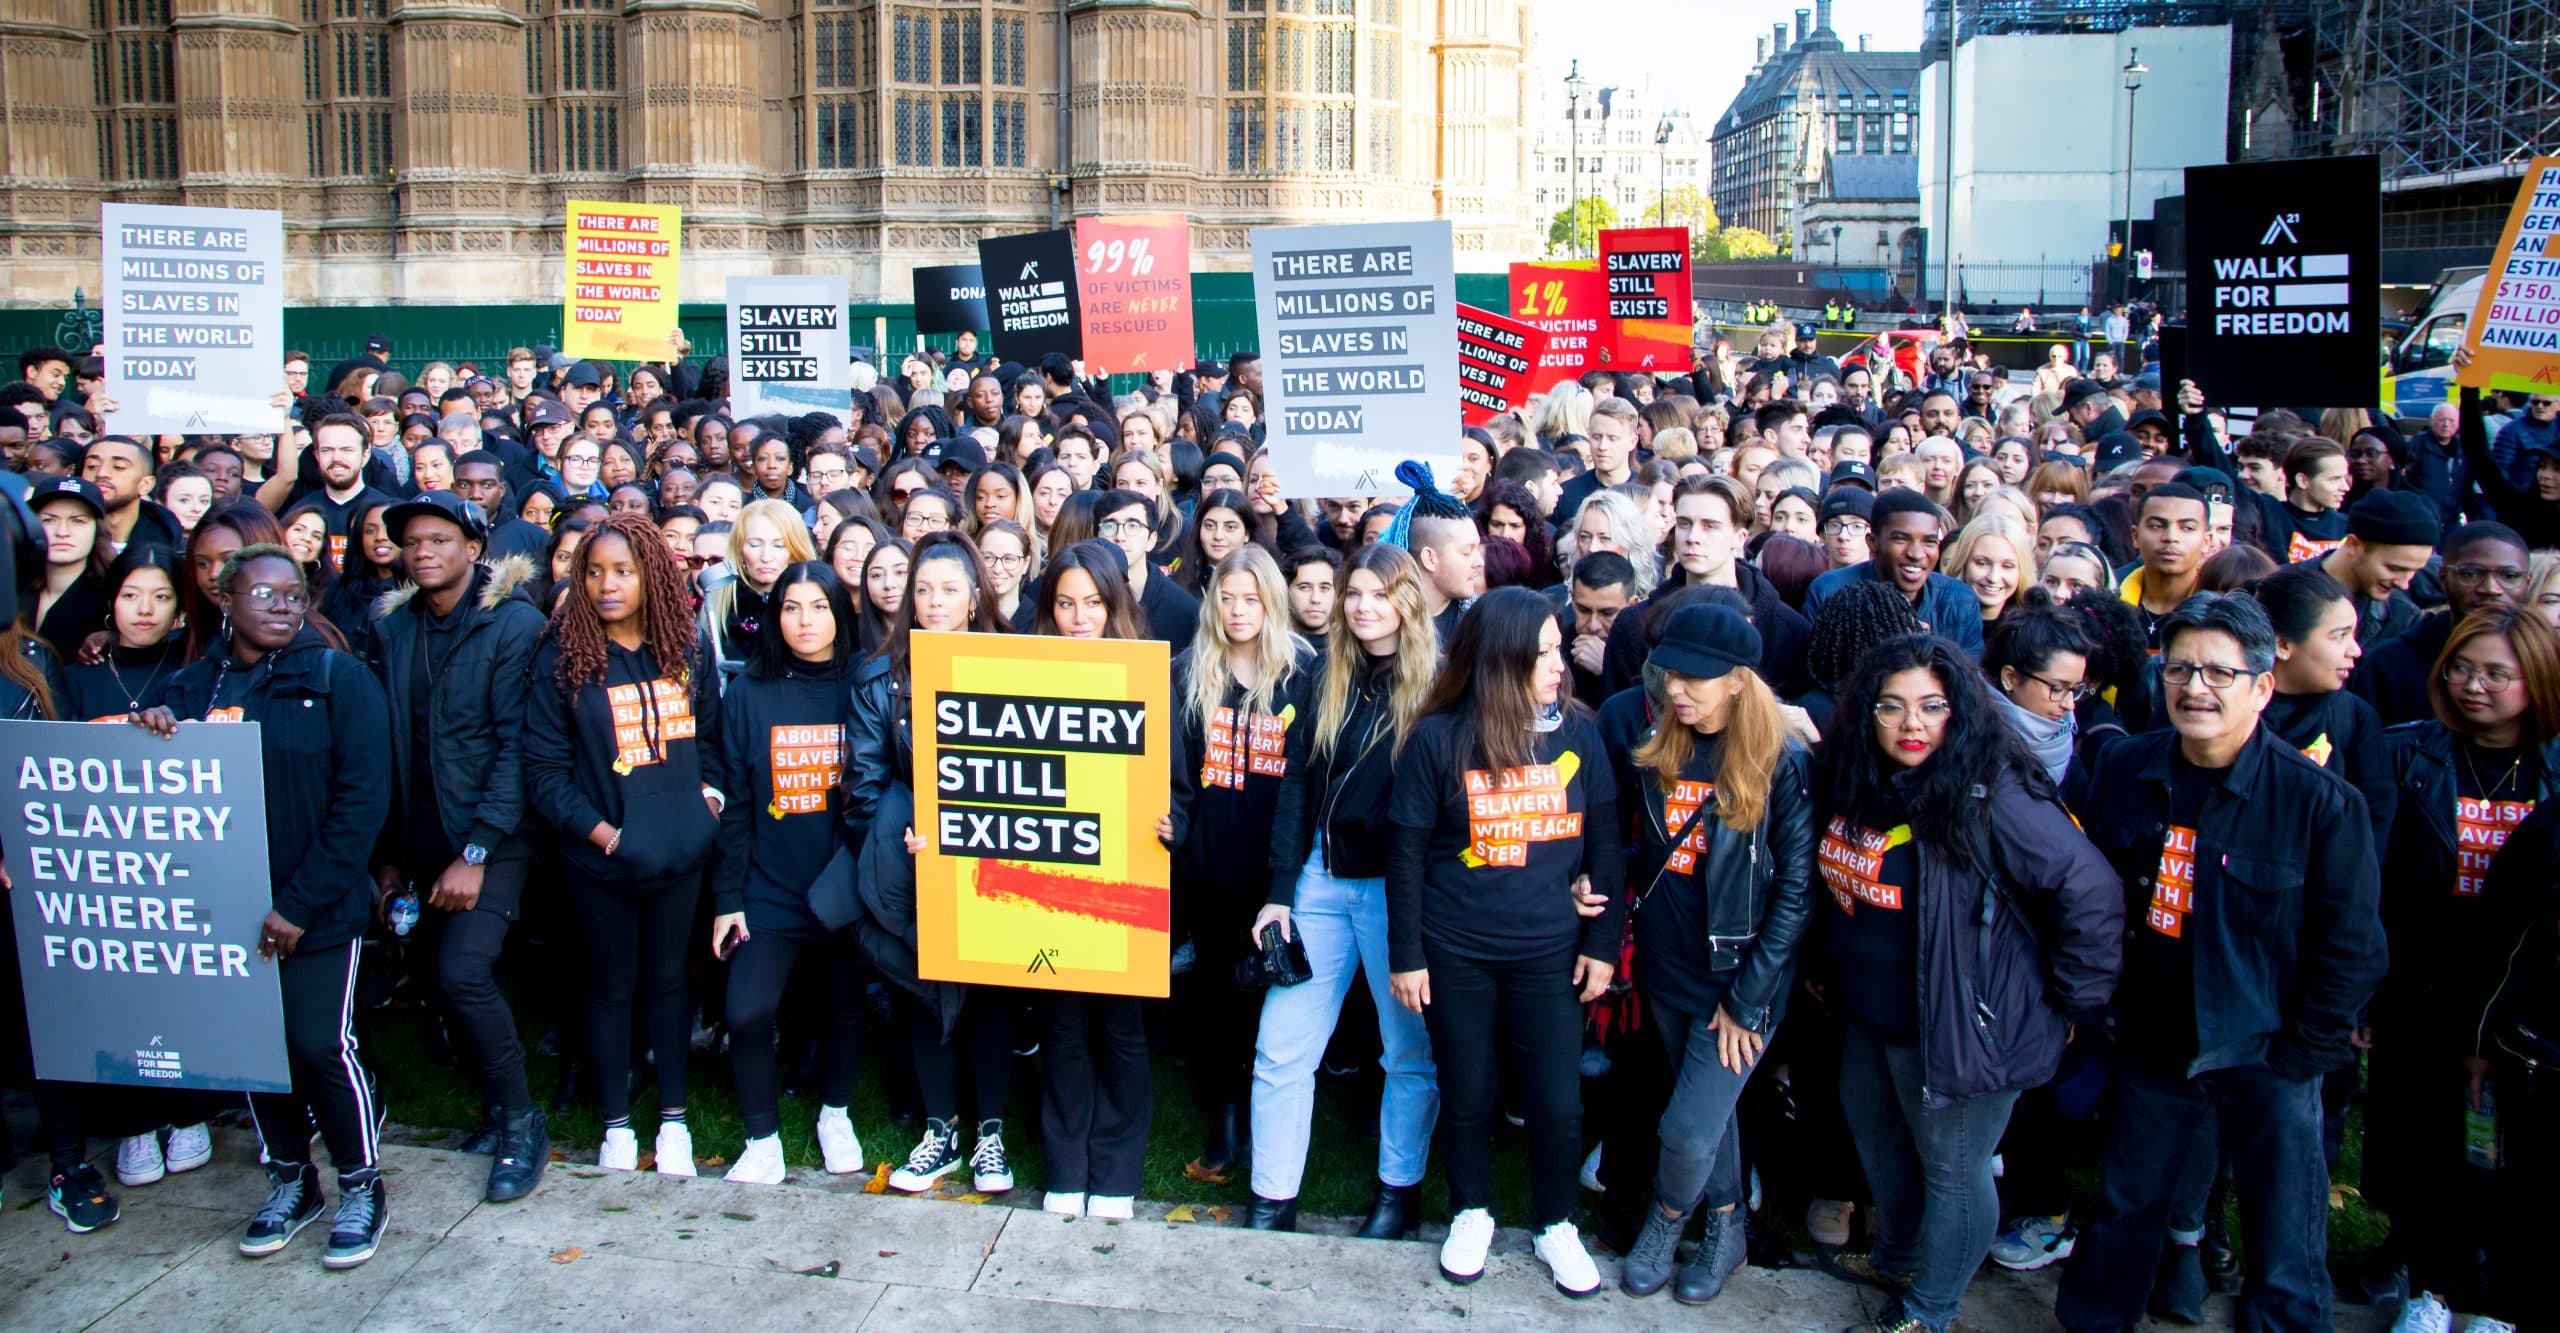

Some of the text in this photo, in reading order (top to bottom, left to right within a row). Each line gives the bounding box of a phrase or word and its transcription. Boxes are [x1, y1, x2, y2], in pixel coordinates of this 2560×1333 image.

[578, 216, 658, 231] THERE ARE
[123, 228, 247, 248] THERE ARE
[578, 239, 669, 254] MILLIONS OF
[2513, 237, 2546, 252] AN
[1087, 238, 1154, 276] 99%
[1273, 252, 1411, 276] THERE ARE
[1608, 254, 1682, 270] SLAVERY
[123, 262, 264, 280] MILLIONS OF
[577, 262, 651, 276] SLAVES IN
[2214, 256, 2297, 280] WALK
[2506, 259, 2560, 277] ESTI
[576, 285, 660, 299] THE WORLD
[999, 284, 1040, 301] WALK
[1088, 279, 1181, 295] OF VICTIMS
[1609, 277, 1654, 292] STILL
[123, 294, 239, 312] SLAVES IN
[1090, 296, 1179, 314] ARE NEVER
[1278, 290, 1433, 315] MILLIONS OF
[1519, 280, 1567, 316] 1%
[2216, 285, 2270, 308] FOR
[576, 309, 622, 321] TODAY
[741, 309, 836, 325] SLAVERY
[1001, 302, 1029, 316] FOR
[1610, 300, 1668, 316] EXISTS
[1004, 312, 1069, 331] FREEDOM
[1091, 320, 1166, 334] RESCUED
[2216, 312, 2349, 335] FREEDOM
[124, 328, 252, 344] THE WORLD
[741, 335, 800, 351] STILL
[1281, 331, 1406, 353] SLAVES IN
[1495, 332, 1524, 348] ARE
[1551, 337, 1587, 349] EVER
[124, 360, 195, 376] TODAY
[742, 361, 817, 377] EXISTS
[1510, 358, 1528, 372] OF
[1283, 370, 1424, 392] THE WORLD
[1491, 374, 1505, 389] IN
[1286, 411, 1362, 430] TODAY
[936, 700, 1146, 744] SLAVERY
[19, 756, 222, 794] ABOLISH
[778, 773, 821, 788] WITH
[938, 756, 1066, 798] STILL
[780, 794, 821, 810] STEP
[1474, 794, 1560, 816] SLAVERY
[24, 801, 232, 841] SLAVERY
[1475, 817, 1577, 839] WITH EACH
[940, 811, 1100, 855] EXISTS
[1476, 841, 1521, 862] STEP
[1819, 840, 1876, 875] SLAVERY
[31, 847, 190, 886] EVERY-
[1852, 879, 1895, 905] EACH
[35, 891, 211, 936] WHERE,
[44, 935, 249, 977] FOREVER
[136, 1050, 163, 1058] WALK
[138, 1059, 156, 1067] FOR
[139, 1069, 182, 1079] FREEDOM
